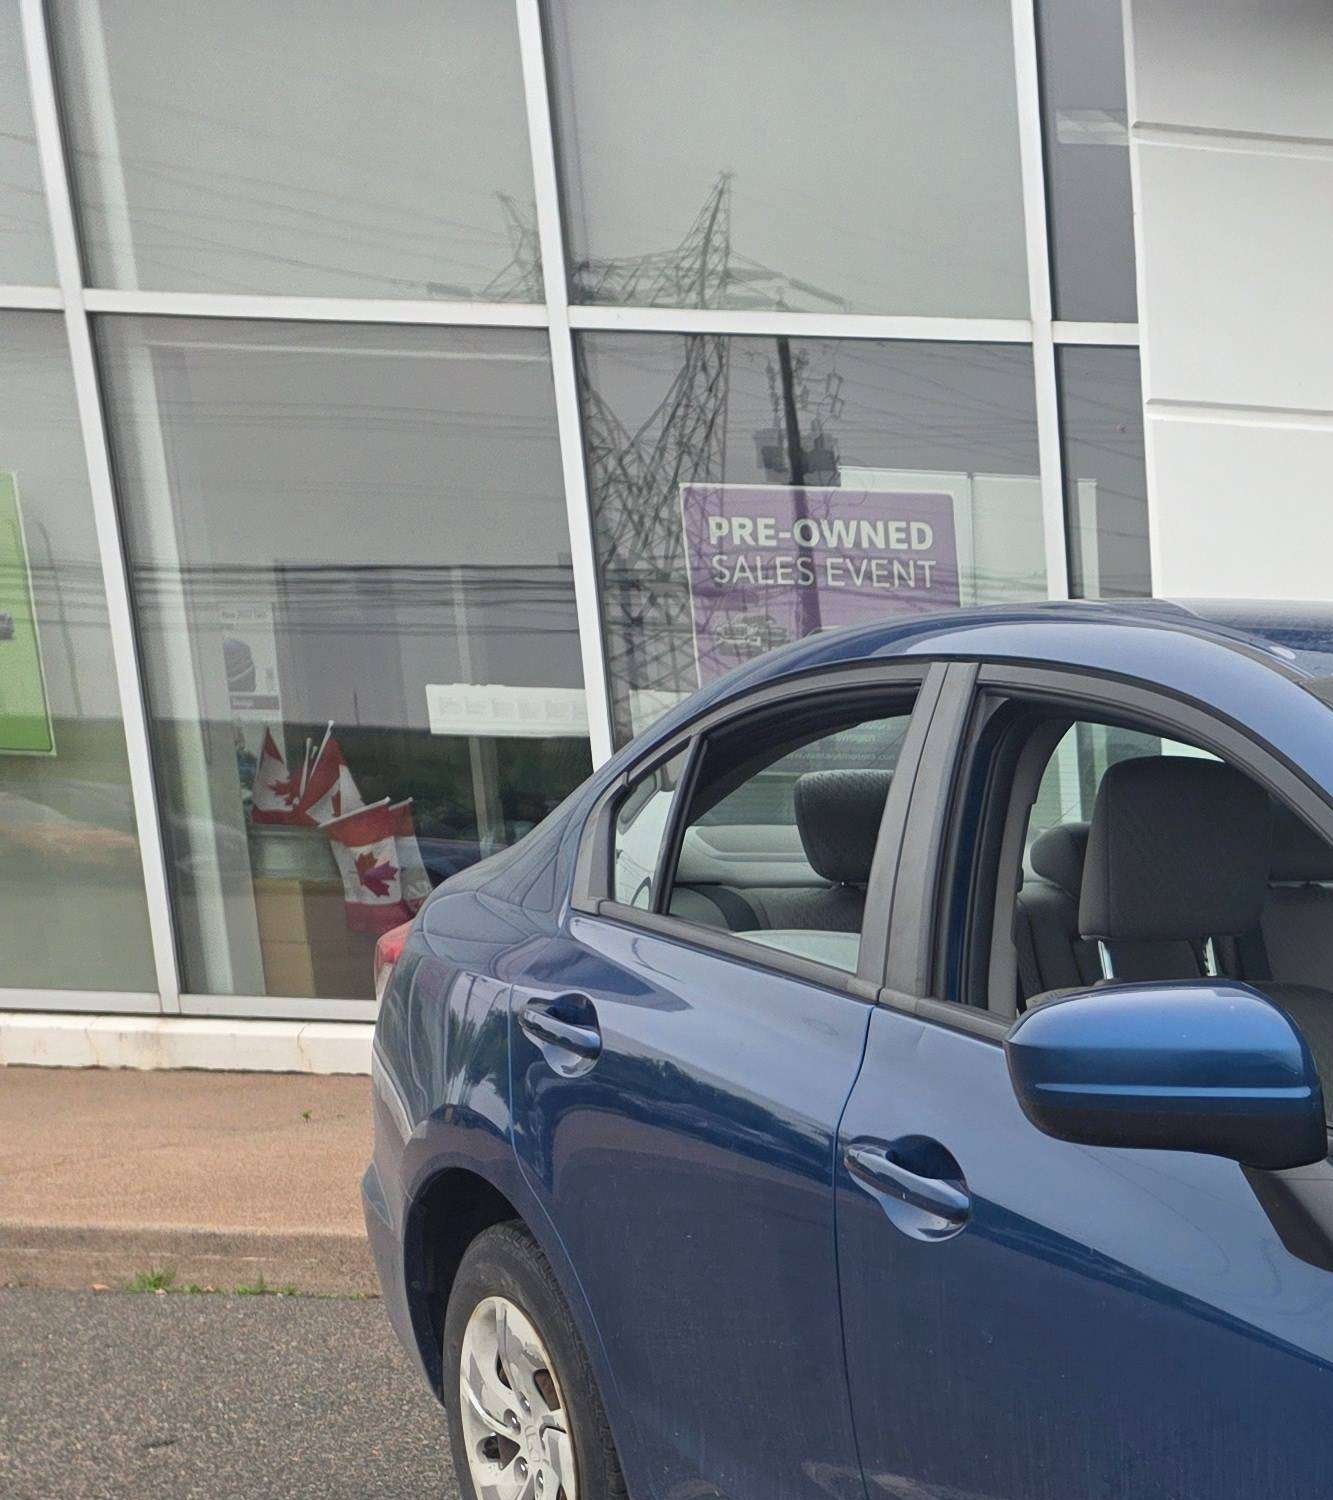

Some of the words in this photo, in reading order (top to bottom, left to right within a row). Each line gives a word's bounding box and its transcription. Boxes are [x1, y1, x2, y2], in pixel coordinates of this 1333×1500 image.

[708, 516, 934, 550] PRE-OWNED
[712, 554, 815, 587] SALES
[826, 557, 937, 589] EVENT
